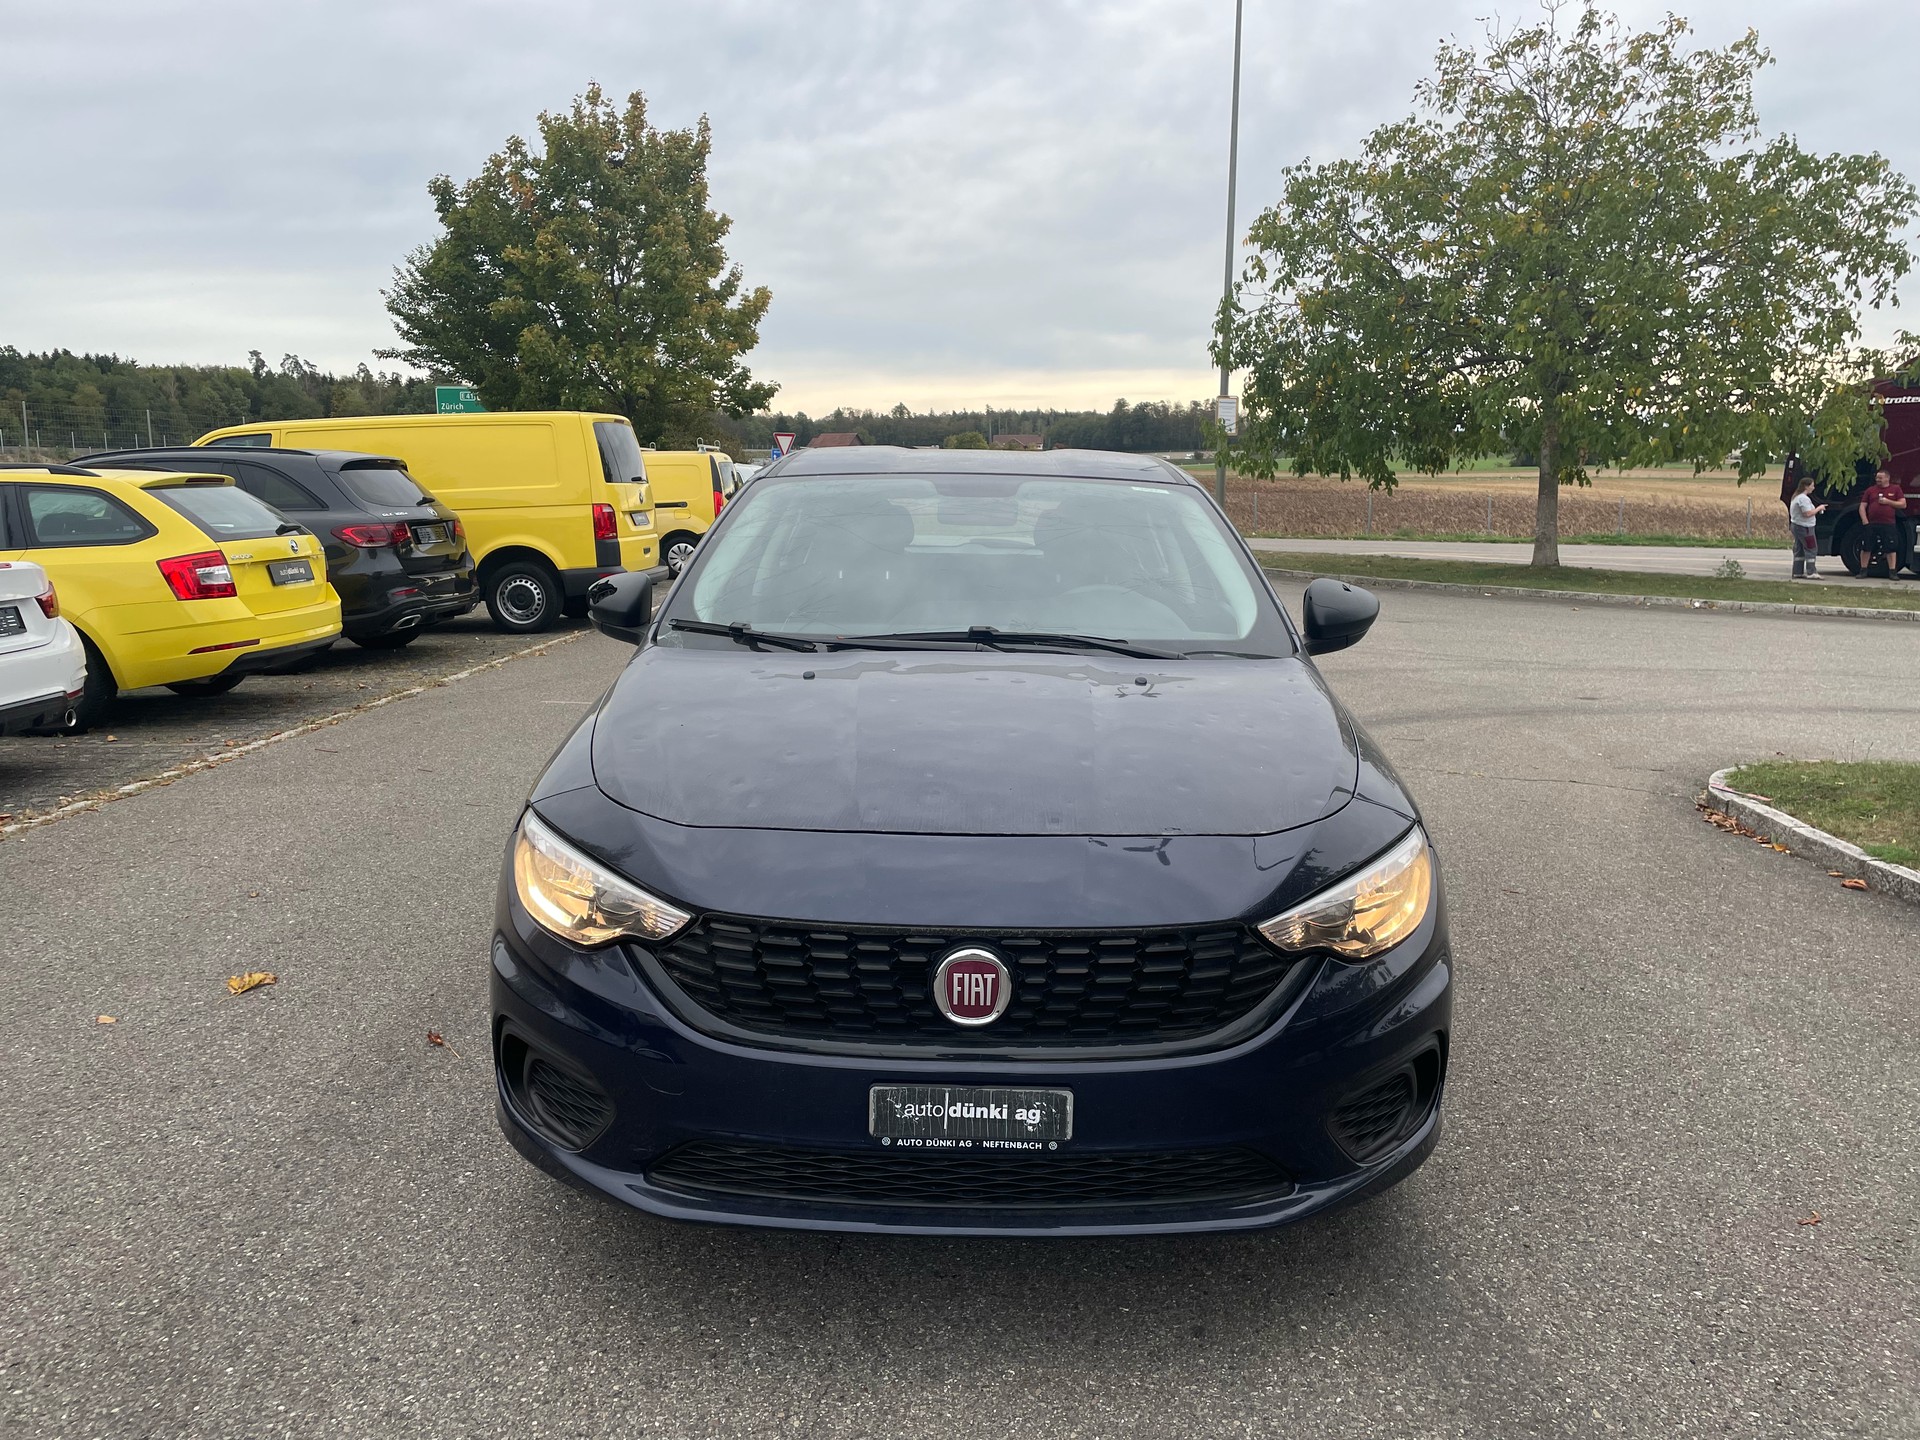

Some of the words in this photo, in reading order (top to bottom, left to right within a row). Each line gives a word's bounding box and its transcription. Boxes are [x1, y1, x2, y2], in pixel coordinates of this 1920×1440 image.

[953, 973, 996, 1006] FIAT
[904, 1103, 944, 1117] auto
[948, 1102, 1008, 1120] dünki
[1015, 1108, 1041, 1124] ag
[896, 1138, 923, 1147] AUTO
[926, 1138, 956, 1148] DÜNKI
[958, 1140, 972, 1148] AG
[983, 1140, 1042, 1150] NEFTENBACH
